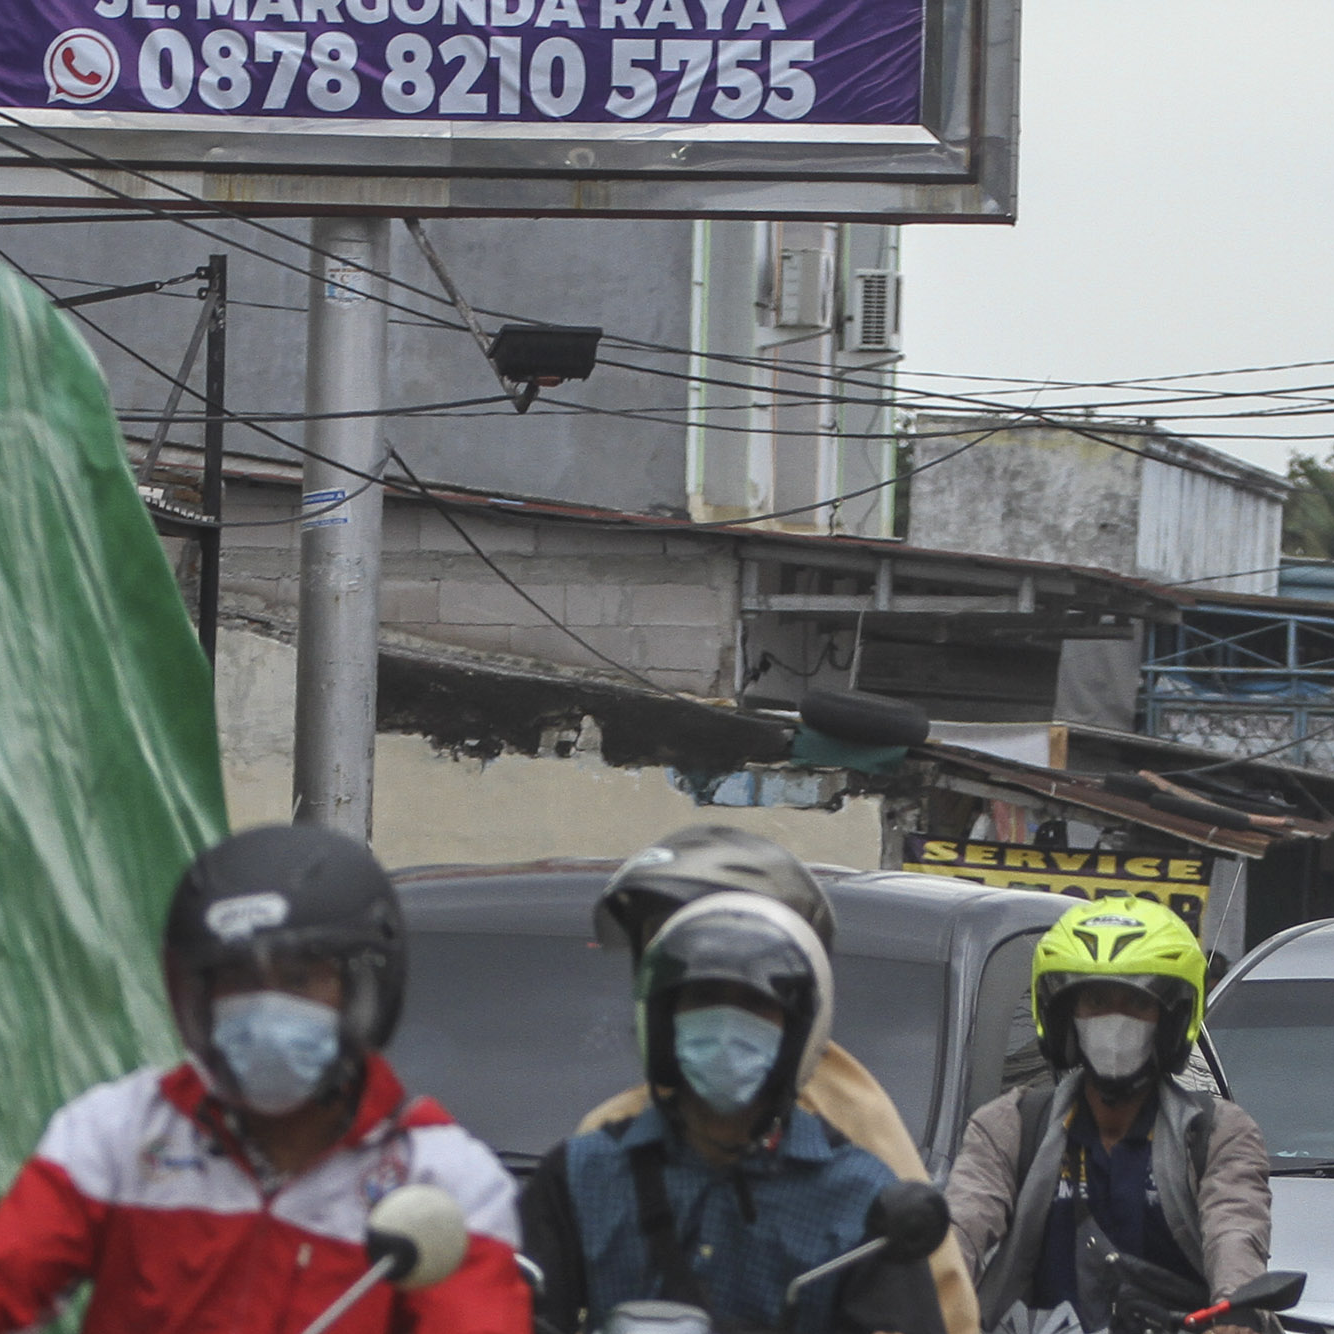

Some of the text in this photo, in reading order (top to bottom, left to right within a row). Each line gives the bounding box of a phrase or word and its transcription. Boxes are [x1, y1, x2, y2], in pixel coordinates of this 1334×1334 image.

[138, 28, 816, 120] 0878 8210 5755
[922, 840, 1203, 880] SERVICE
